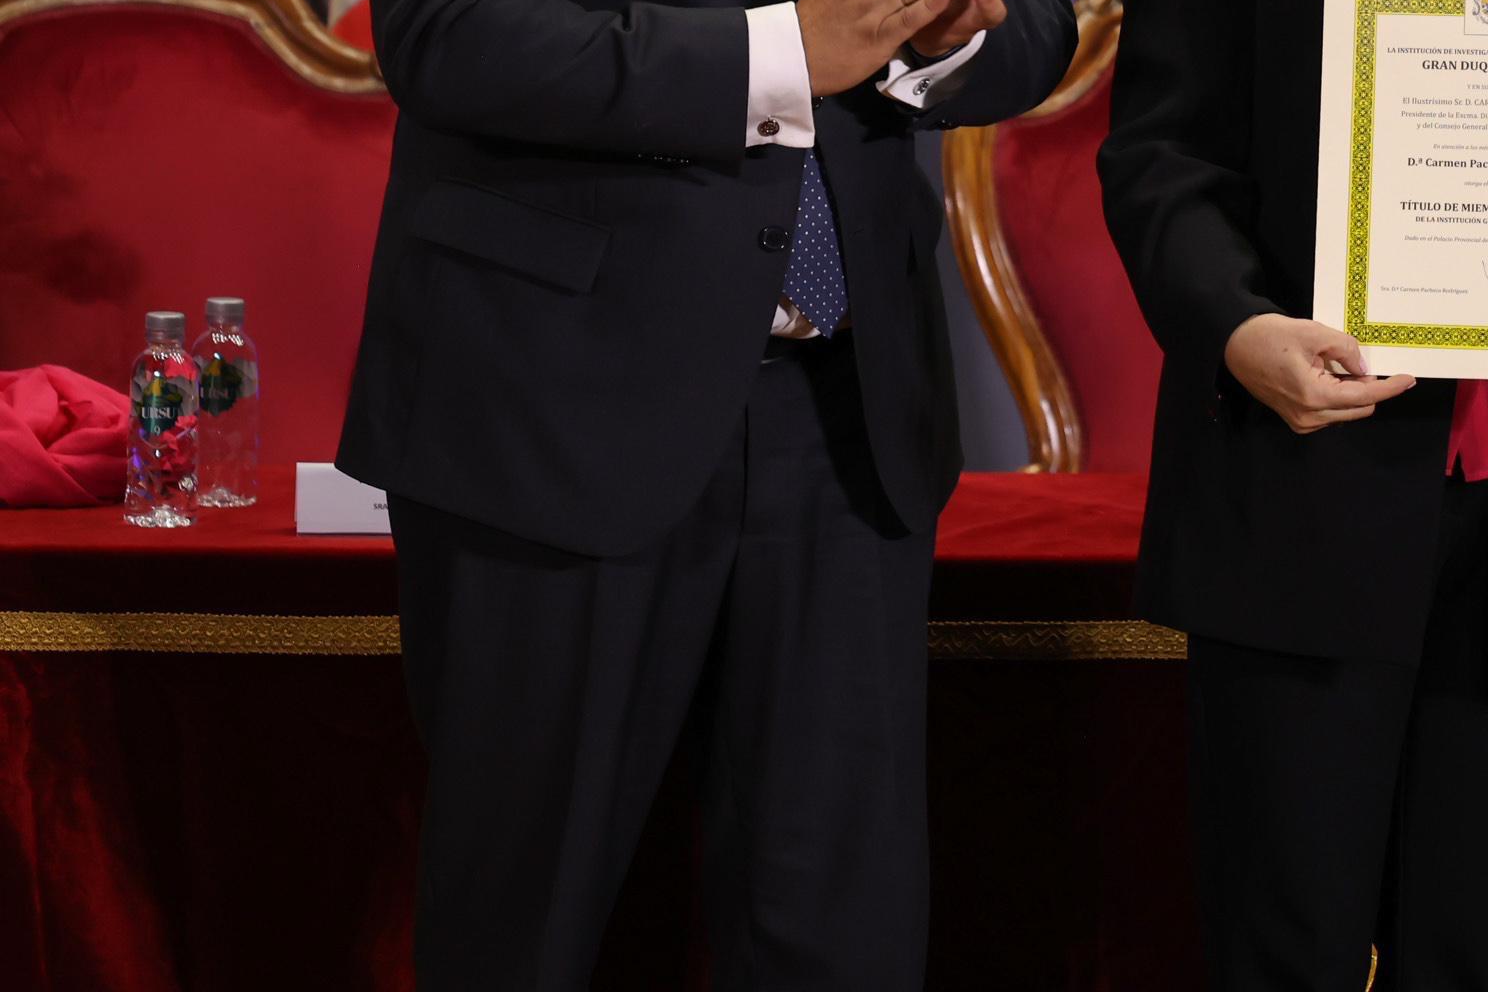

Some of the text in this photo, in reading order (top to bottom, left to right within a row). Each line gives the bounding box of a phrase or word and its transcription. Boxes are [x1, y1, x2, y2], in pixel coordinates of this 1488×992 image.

[1397, 46, 1442, 54] INSTITUCIÓN
[1422, 59, 1457, 70] GRAN
[1402, 96, 1410, 104] El
[1465, 98, 1472, 106] D.
[1401, 110, 1437, 118] Presidente
[1438, 111, 1447, 119] de
[1447, 111, 1454, 119] la
[1434, 122, 1461, 130] Consejo
[1461, 122, 1488, 130] General
[1407, 157, 1424, 166] D.ª
[1425, 157, 1468, 167] Carmen
[1399, 199, 1441, 210] TÍTULO
[1443, 202, 1459, 211] DE
[1415, 215, 1425, 223] DE
[1436, 215, 1481, 224] INSTITUCIÓN
